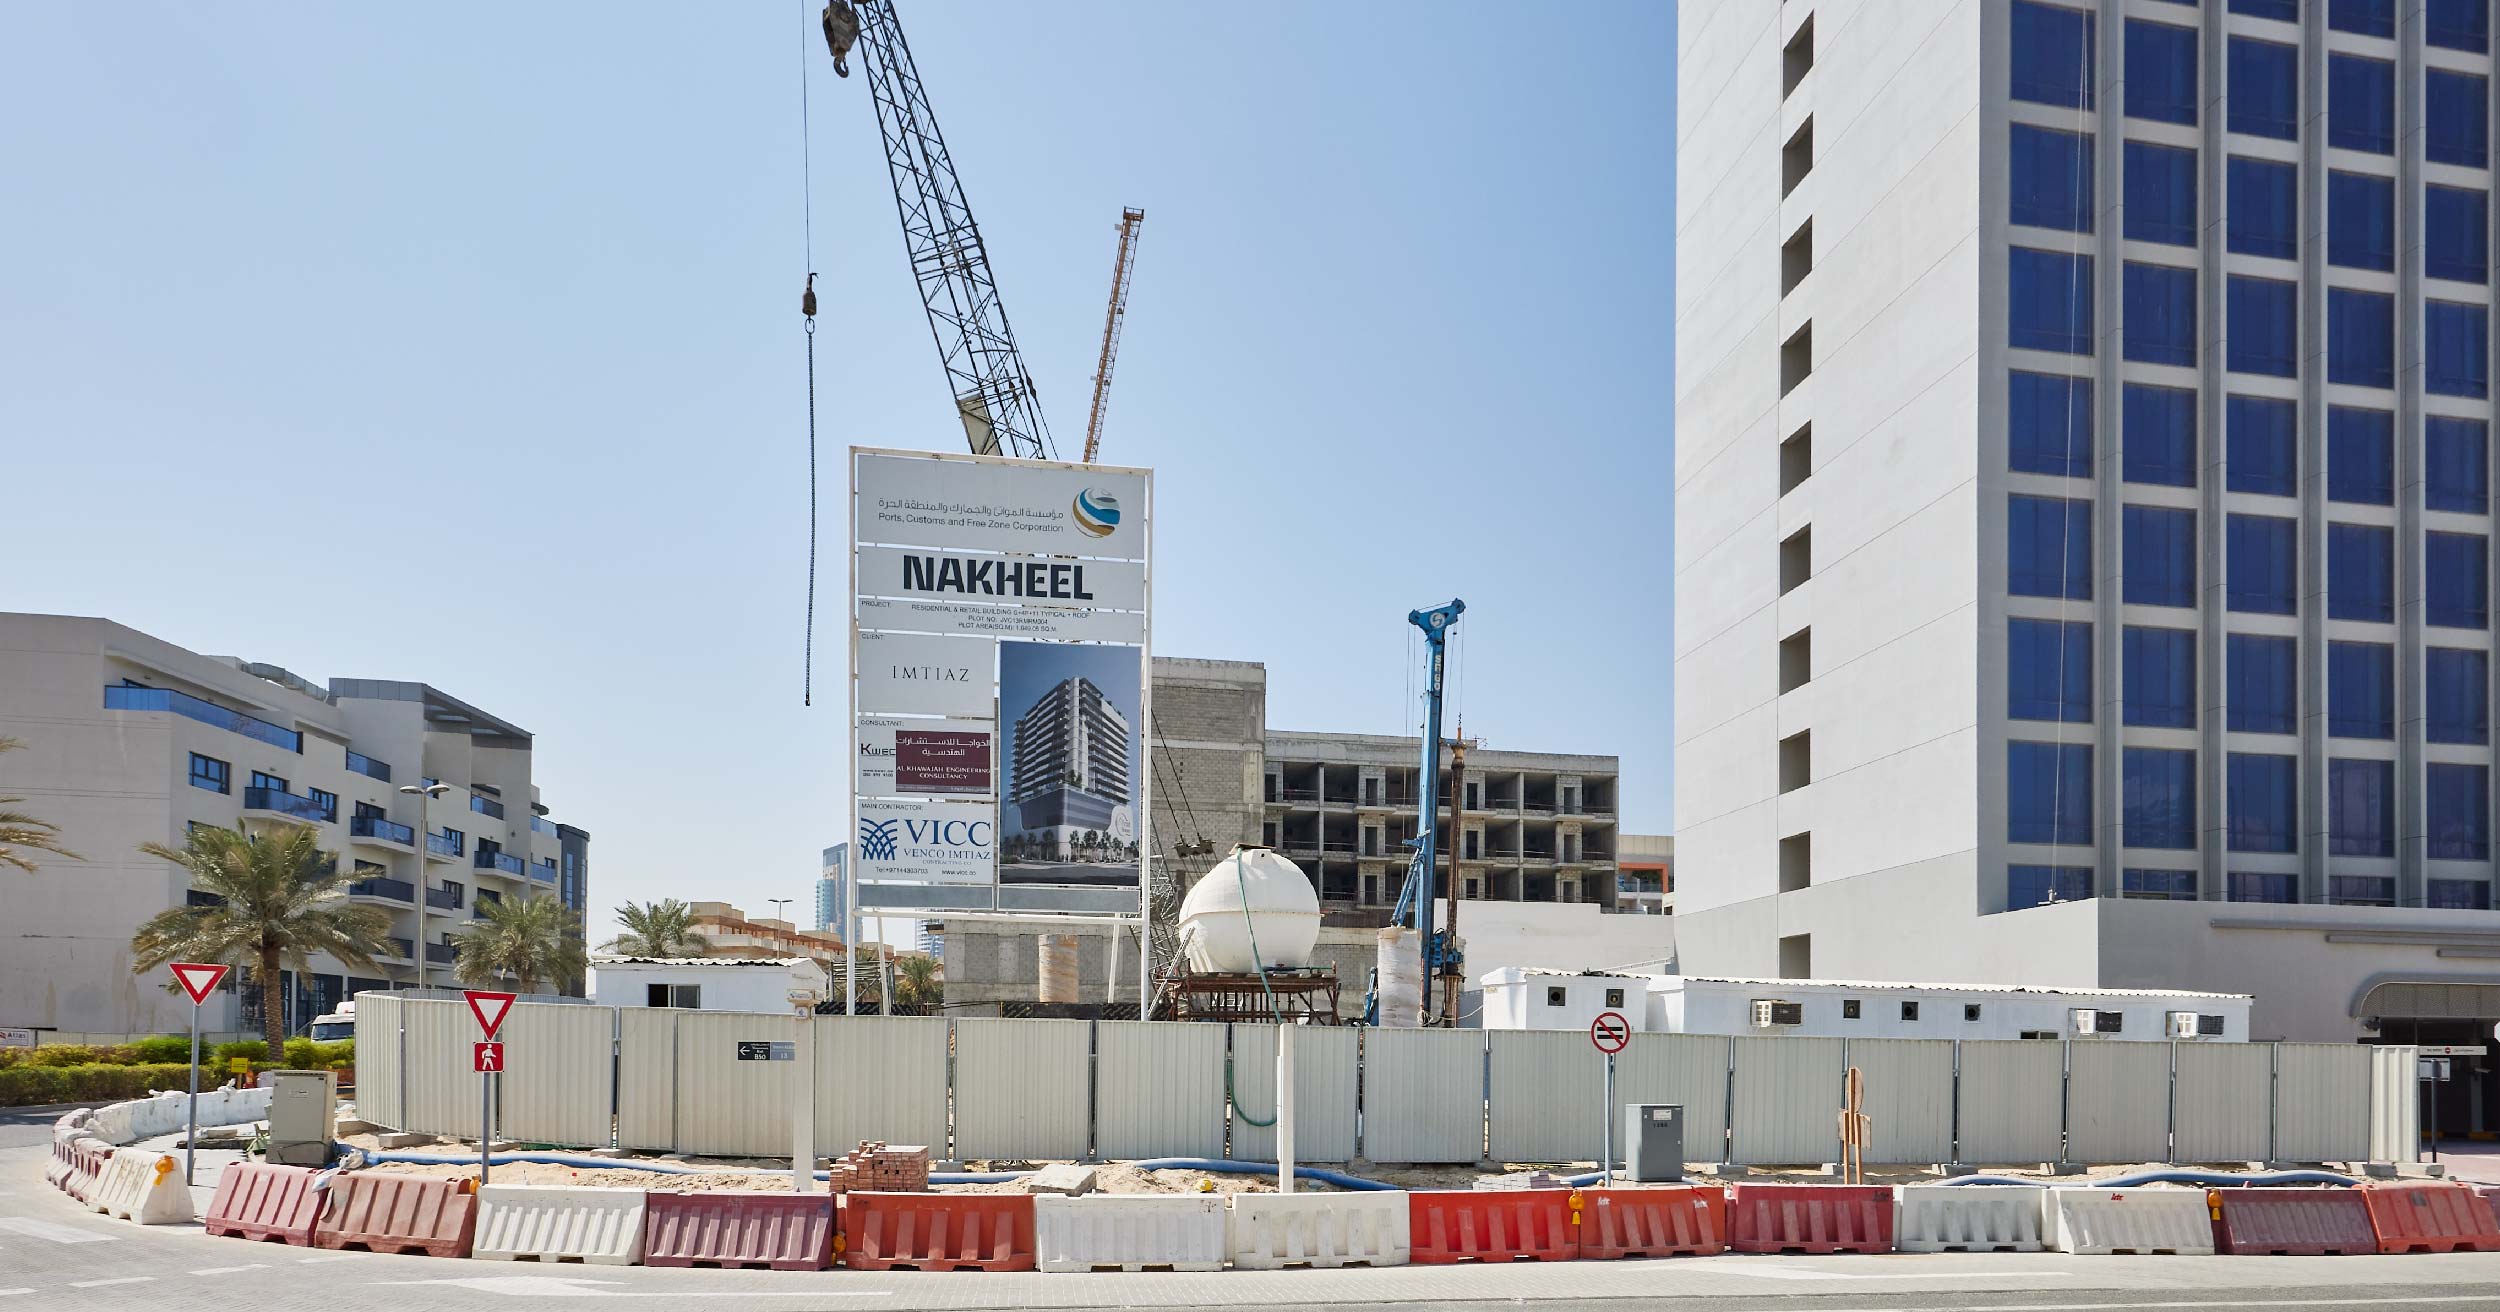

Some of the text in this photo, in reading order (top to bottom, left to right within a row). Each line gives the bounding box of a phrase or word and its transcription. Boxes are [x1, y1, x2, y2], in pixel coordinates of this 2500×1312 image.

[879, 497, 903, 510] الحرة
[879, 512, 1064, 533] Ports, Customs and Free Zone Corporation
[903, 554, 1094, 601] NAKHEEL
[912, 604, 952, 613] RESIDENTIAL
[960, 607, 982, 615] RETAIL
[983, 607, 1012, 616] BUILDING
[893, 665, 969, 682] IMTIAZ
[897, 765, 905, 773] AL
[906, 765, 944, 774] KHAWAJAH
[919, 772, 968, 780] CONSULTANCY
[904, 818, 991, 847] VICC
[903, 848, 991, 860] VENCO IMTIAZ
